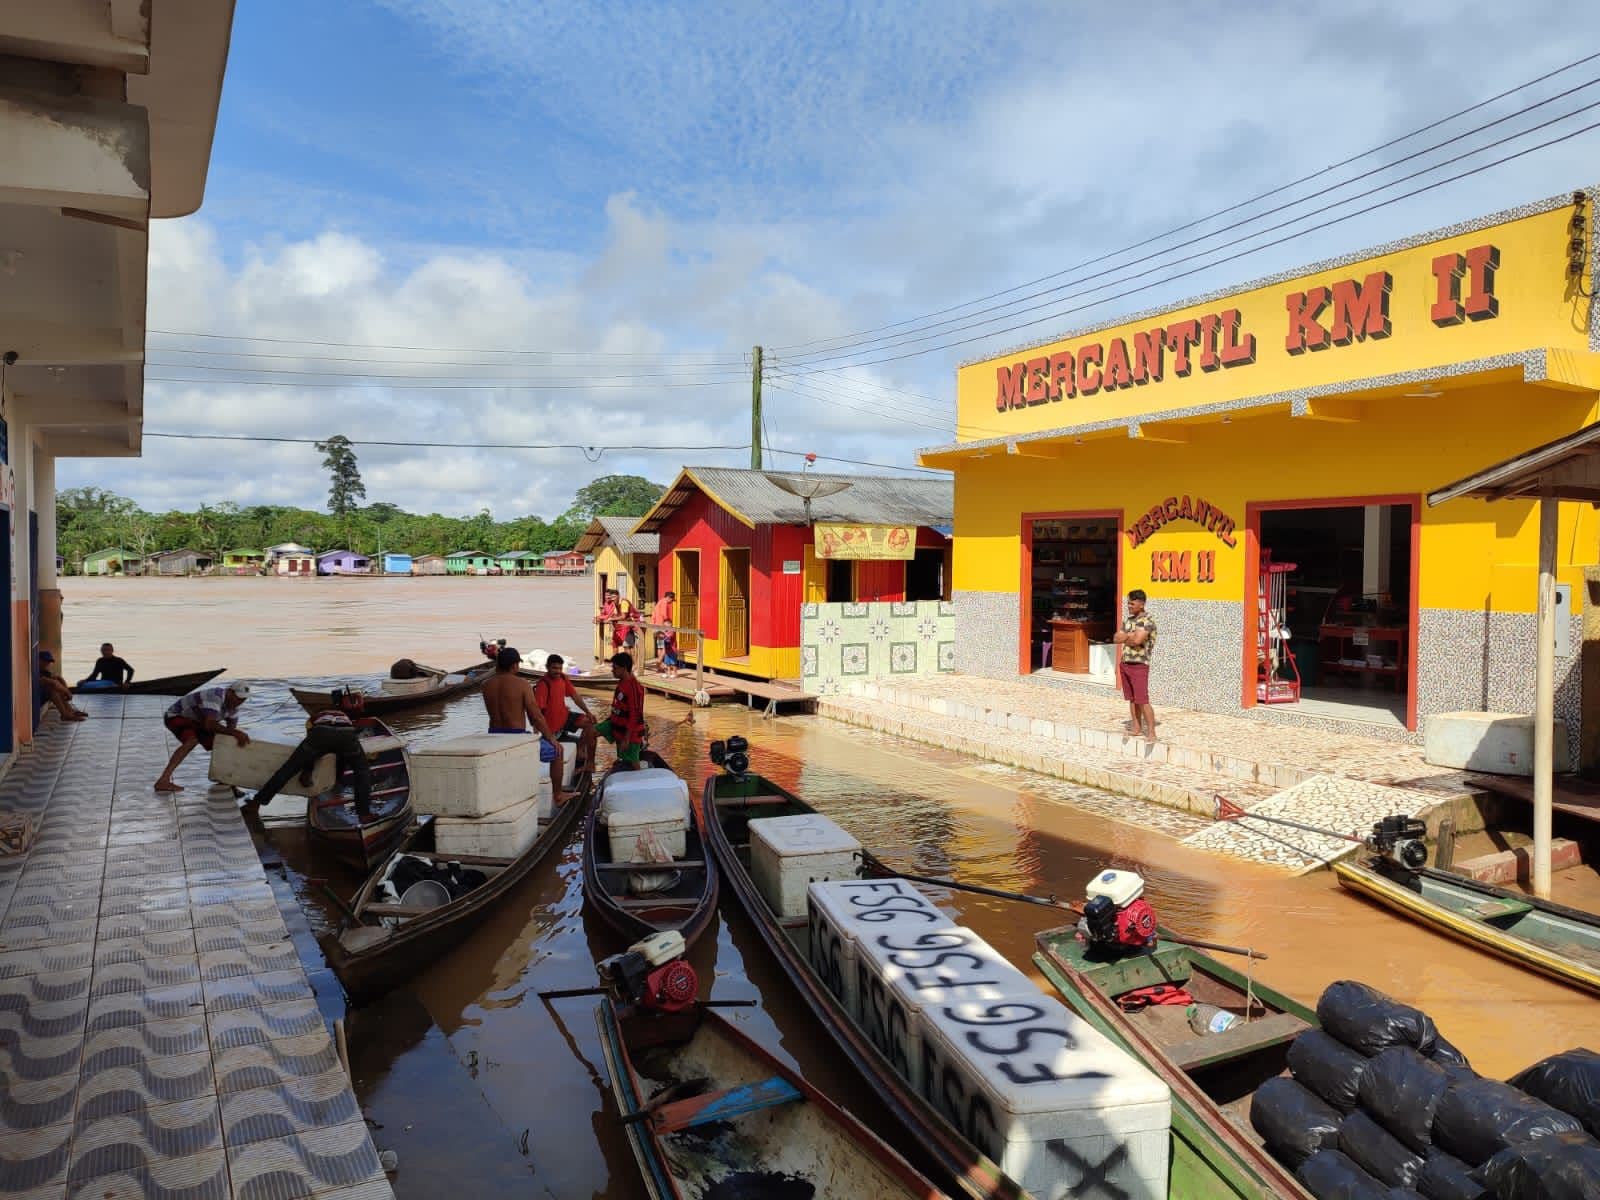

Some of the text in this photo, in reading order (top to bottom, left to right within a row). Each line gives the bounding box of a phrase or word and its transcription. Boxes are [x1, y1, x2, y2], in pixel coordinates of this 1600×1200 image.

[996, 244, 1499, 412] MERCANTIL KM II
[1126, 495, 1237, 549] MERCANTIL
[1151, 550, 1215, 583] KM II
[840, 882, 937, 922] FSG
[876, 932, 998, 991] FSG
[943, 1003, 1115, 1084] FSG
